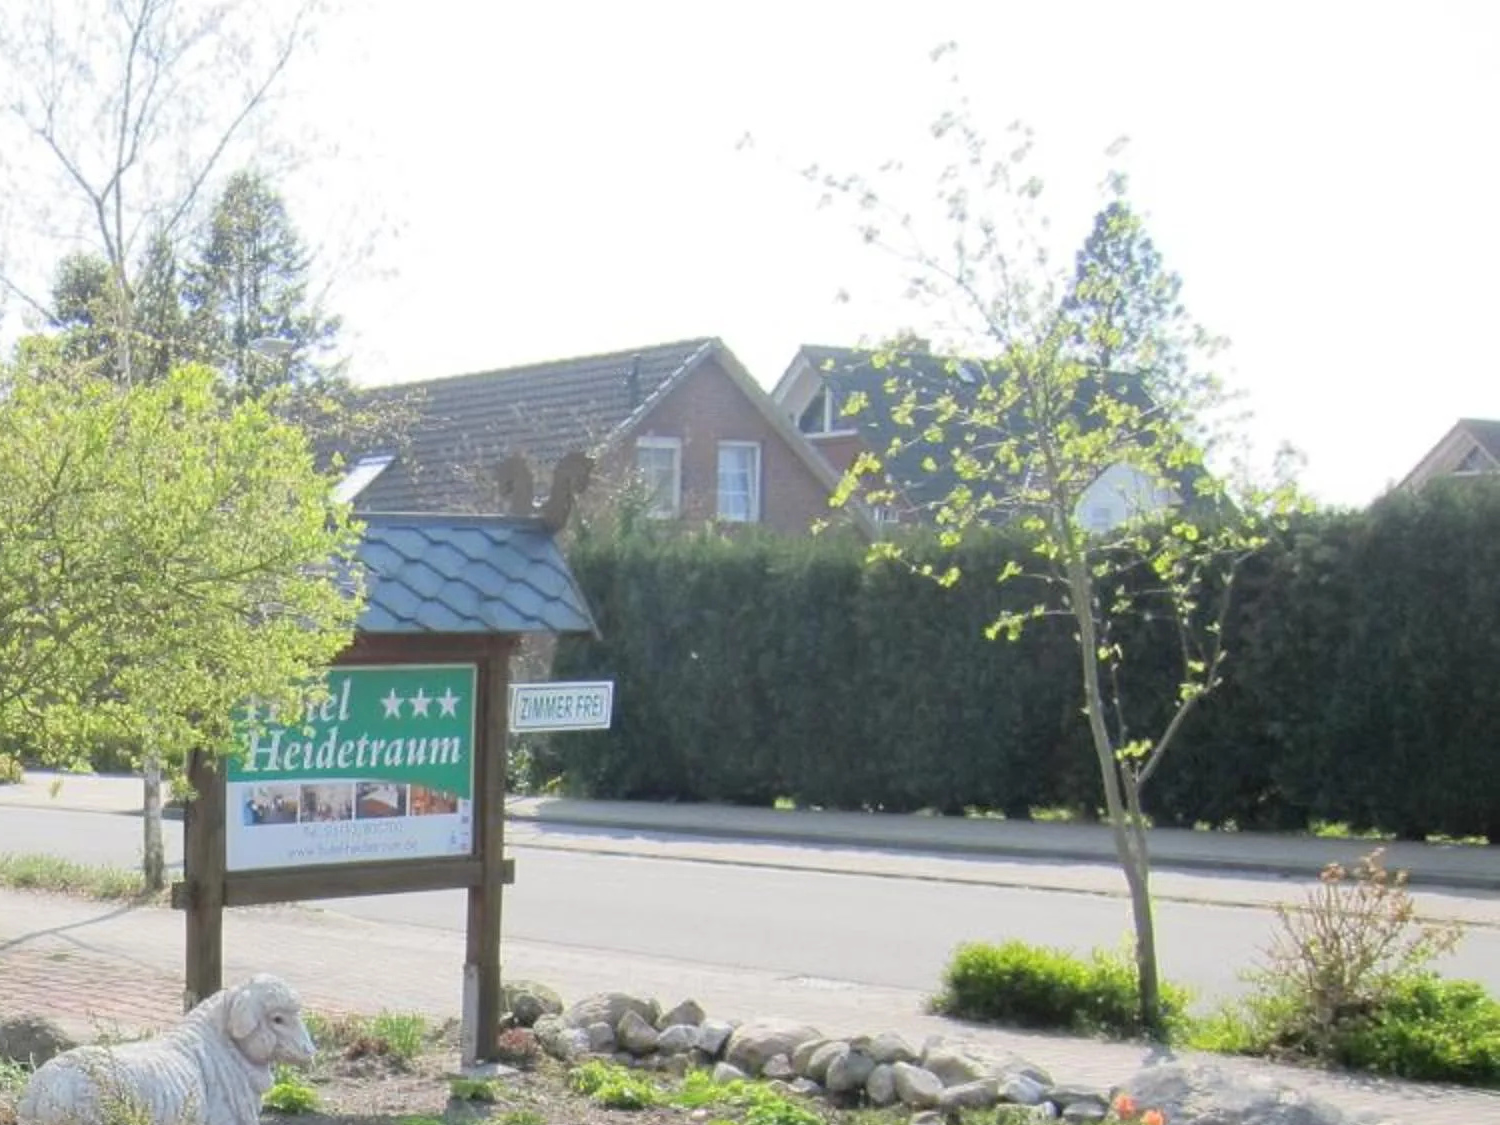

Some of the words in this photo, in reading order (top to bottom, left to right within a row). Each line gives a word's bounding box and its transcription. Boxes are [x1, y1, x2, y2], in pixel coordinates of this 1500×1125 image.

[243, 678, 352, 723] Hel
[520, 695, 574, 720] ZIMMER
[577, 693, 606, 718] FREI
[241, 725, 462, 772] Heidetraum
